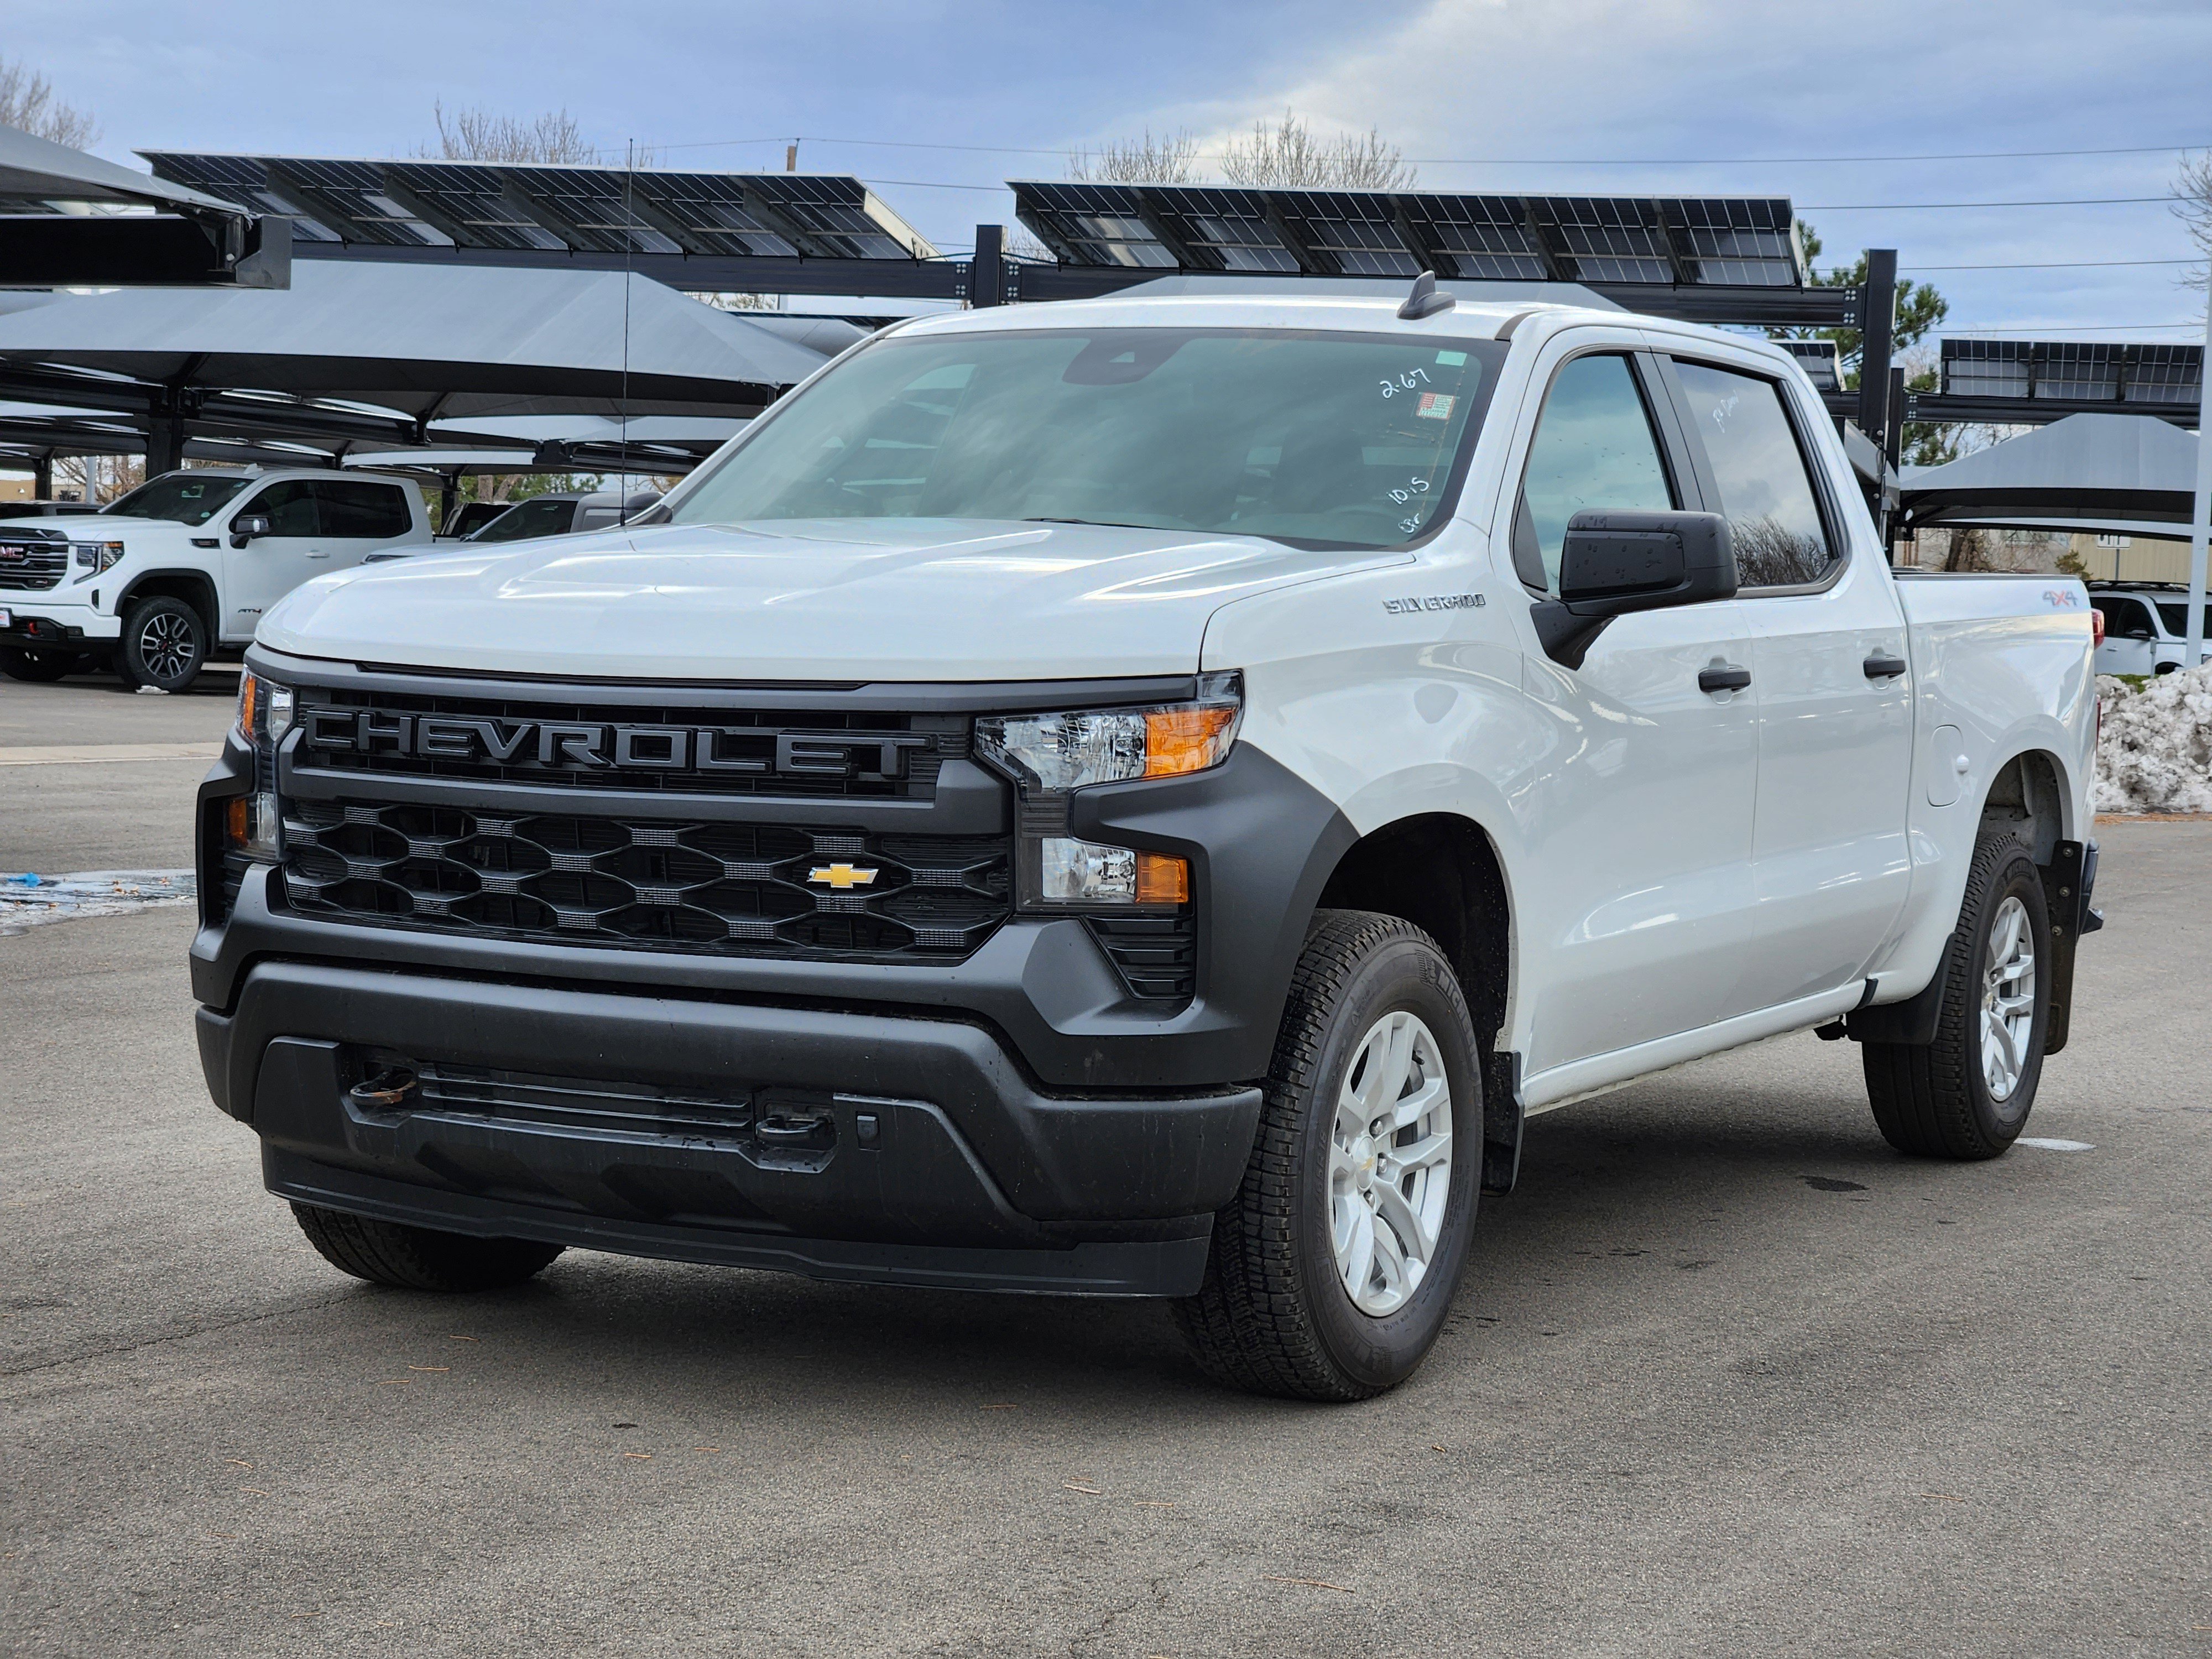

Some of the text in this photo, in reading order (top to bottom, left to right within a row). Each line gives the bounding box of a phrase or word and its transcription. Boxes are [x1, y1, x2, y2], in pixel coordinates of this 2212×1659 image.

[0, 546, 24, 559] MC
[1383, 593, 1486, 614] SILVERADO
[305, 709, 938, 779] CHEVROLET
